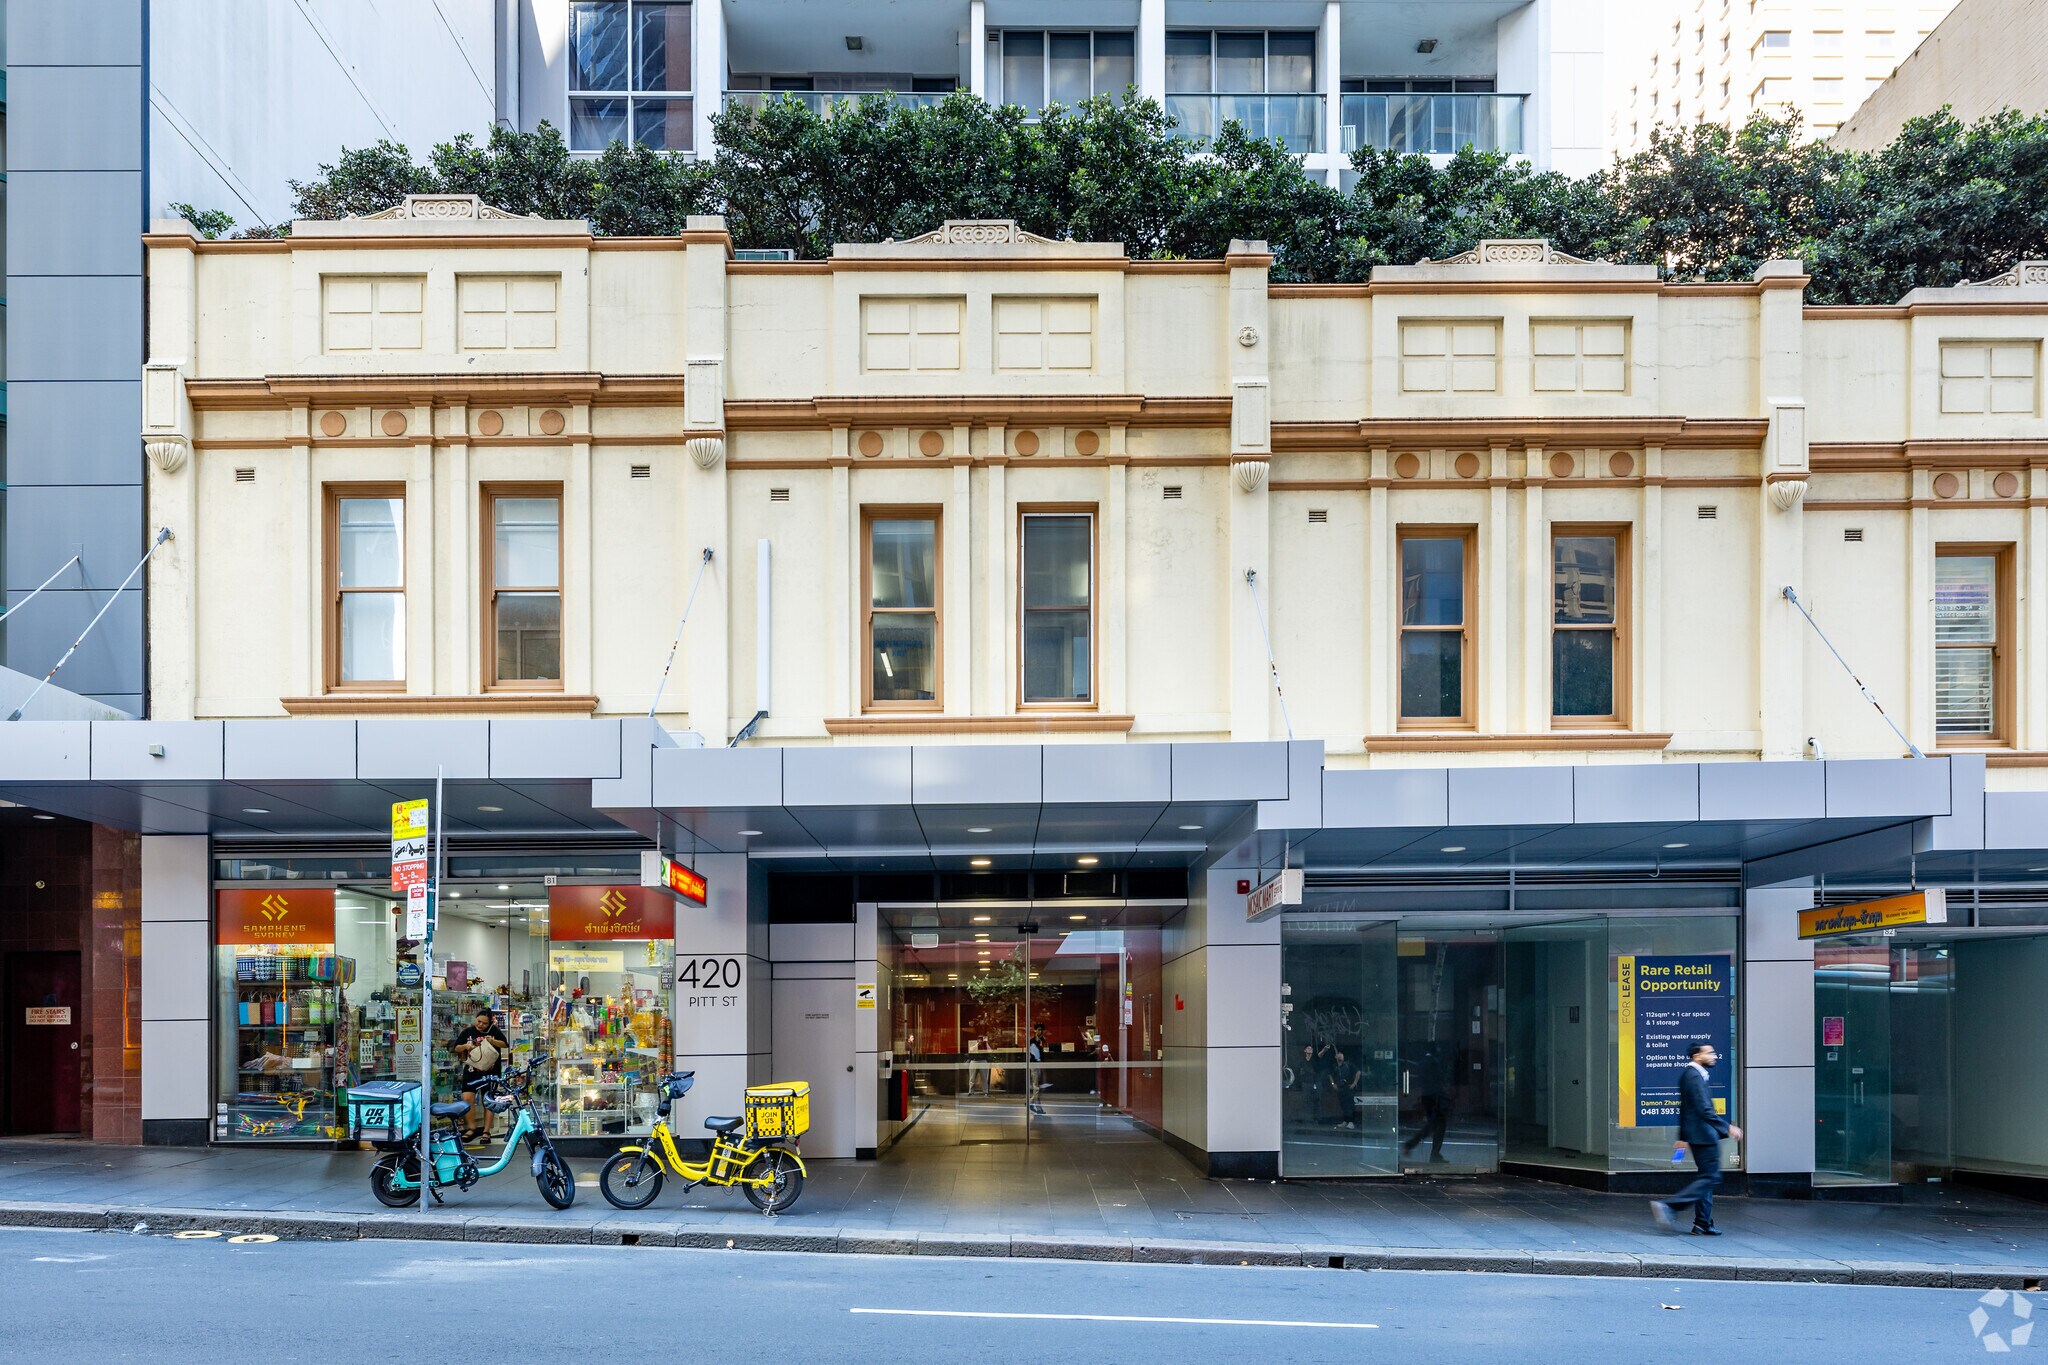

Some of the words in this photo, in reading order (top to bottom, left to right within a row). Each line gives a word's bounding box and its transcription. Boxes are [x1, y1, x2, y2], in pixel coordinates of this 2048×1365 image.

[402, 863, 425, 871] STOPPING
[678, 958, 741, 989] 420
[1640, 965, 1670, 976] Rare
[1674, 964, 1712, 975] Retail
[1622, 963, 1631, 998] LEASE
[1640, 979, 1721, 993] Opportunity
[689, 996, 718, 1007] PITT
[722, 995, 738, 1007] ST
[1622, 1001, 1631, 1024] FOR
[365, 1108, 385, 1117] OR
[1641, 1108, 1659, 1116] 0481
[366, 1117, 383, 1125] CA
